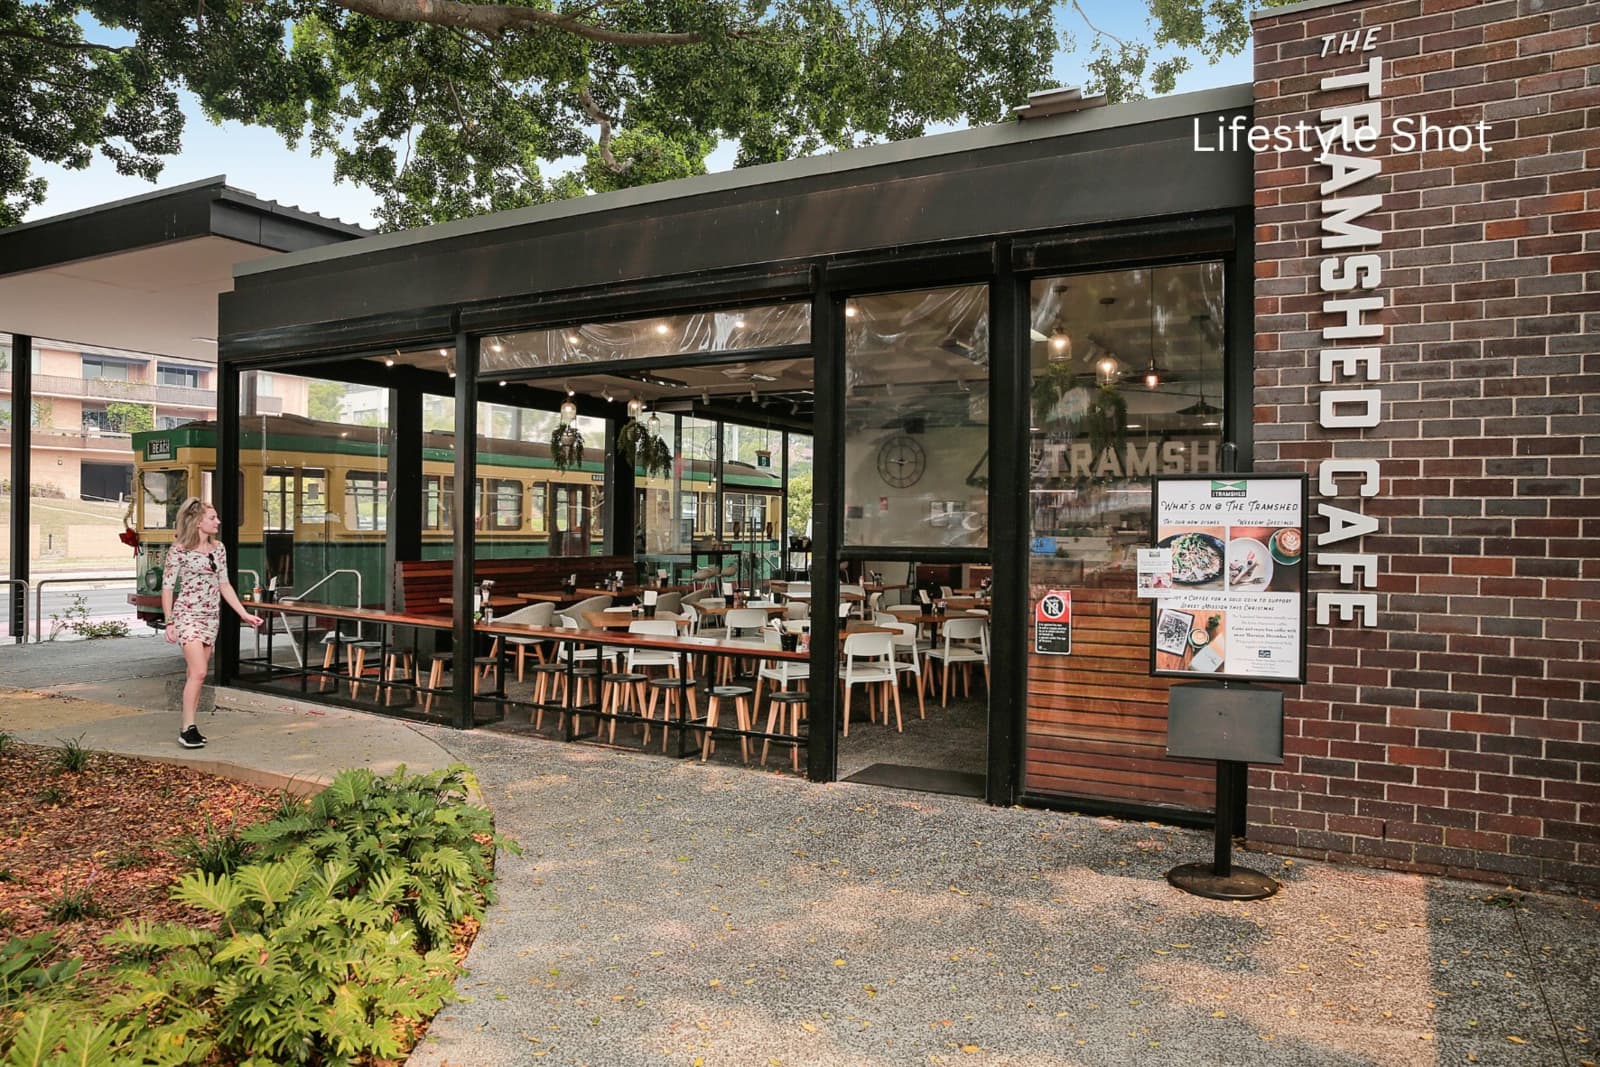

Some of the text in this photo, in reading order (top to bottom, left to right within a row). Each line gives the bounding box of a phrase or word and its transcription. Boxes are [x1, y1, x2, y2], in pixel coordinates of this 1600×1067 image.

[1320, 26, 1383, 58] THE
[1316, 56, 1384, 627] TRAMSHED CAFE
